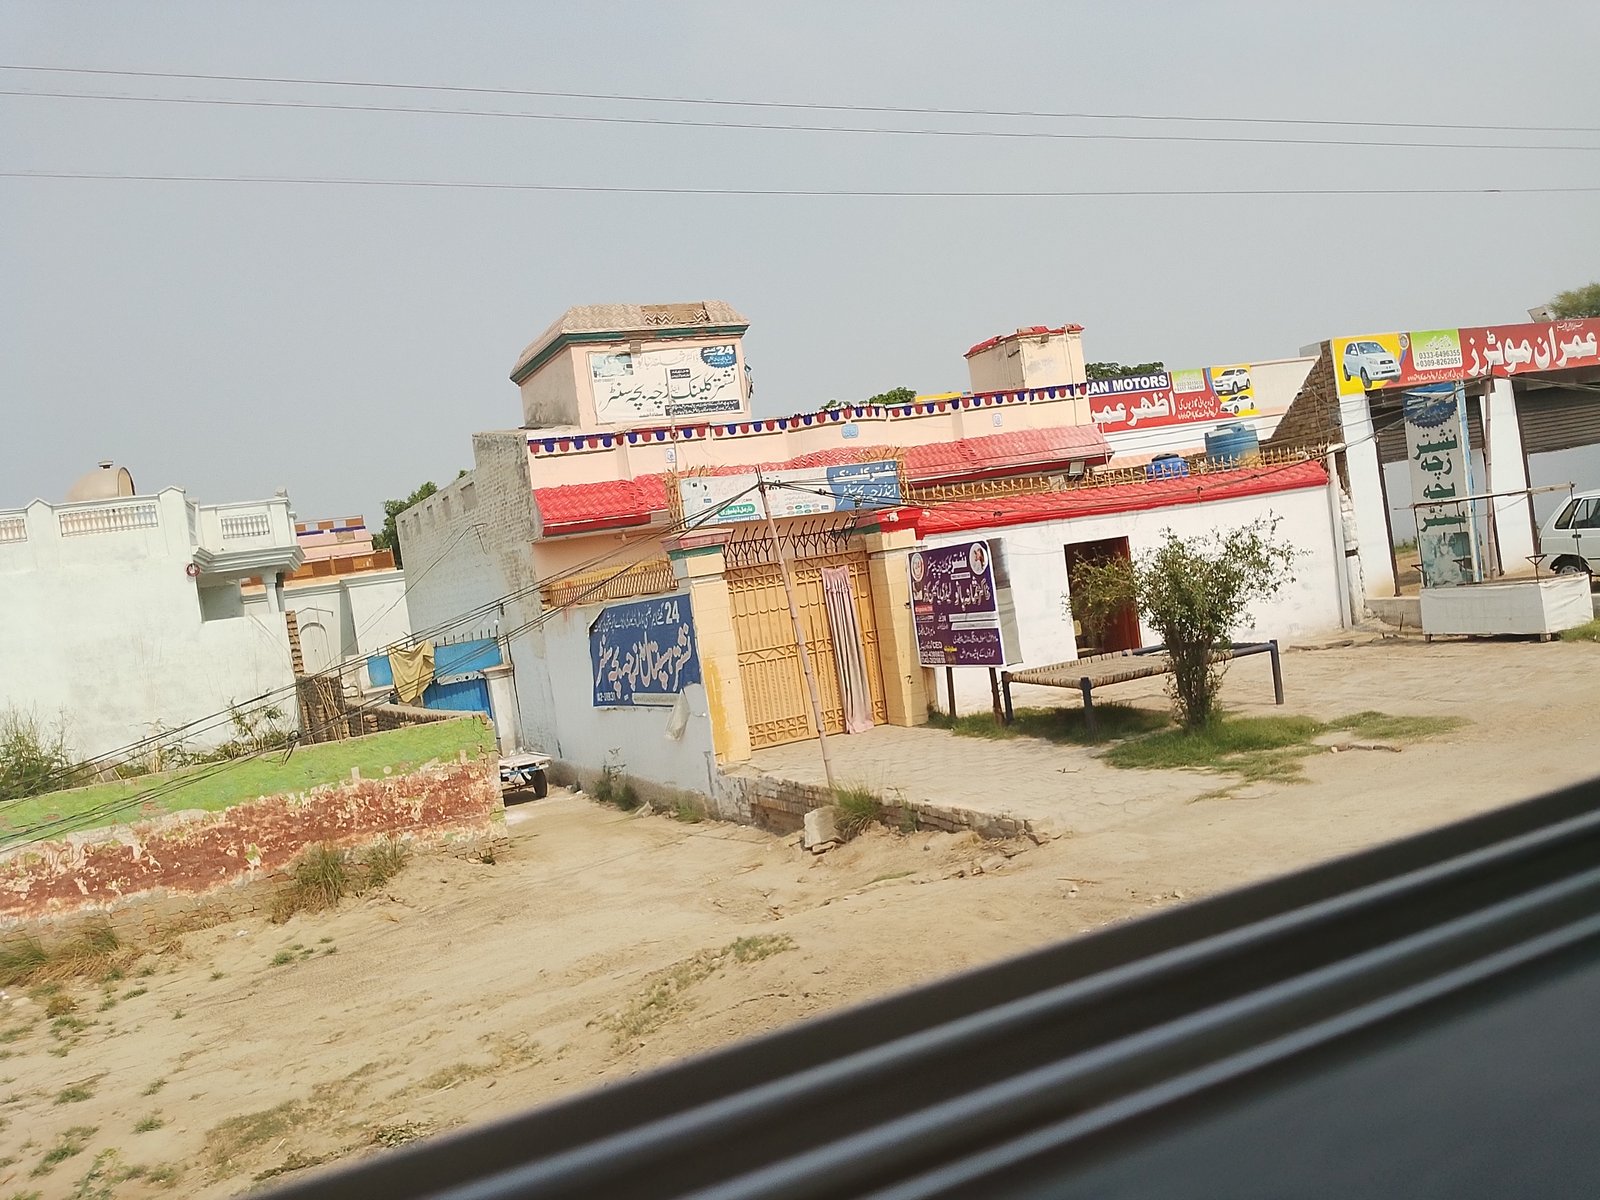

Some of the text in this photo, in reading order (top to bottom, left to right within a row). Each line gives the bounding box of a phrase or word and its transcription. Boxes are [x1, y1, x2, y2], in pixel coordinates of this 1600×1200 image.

[716, 345, 734, 355] 24
[1467, 326, 1598, 377] عمران موٹرز
[671, 373, 716, 401] کلینک
[709, 367, 735, 400] نشتر
[1113, 374, 1168, 391] MOTORS
[1127, 391, 1175, 426] اظہر
[1413, 428, 1458, 460] نشتر
[1420, 451, 1453, 480] زچہ
[664, 600, 680, 625] 24
